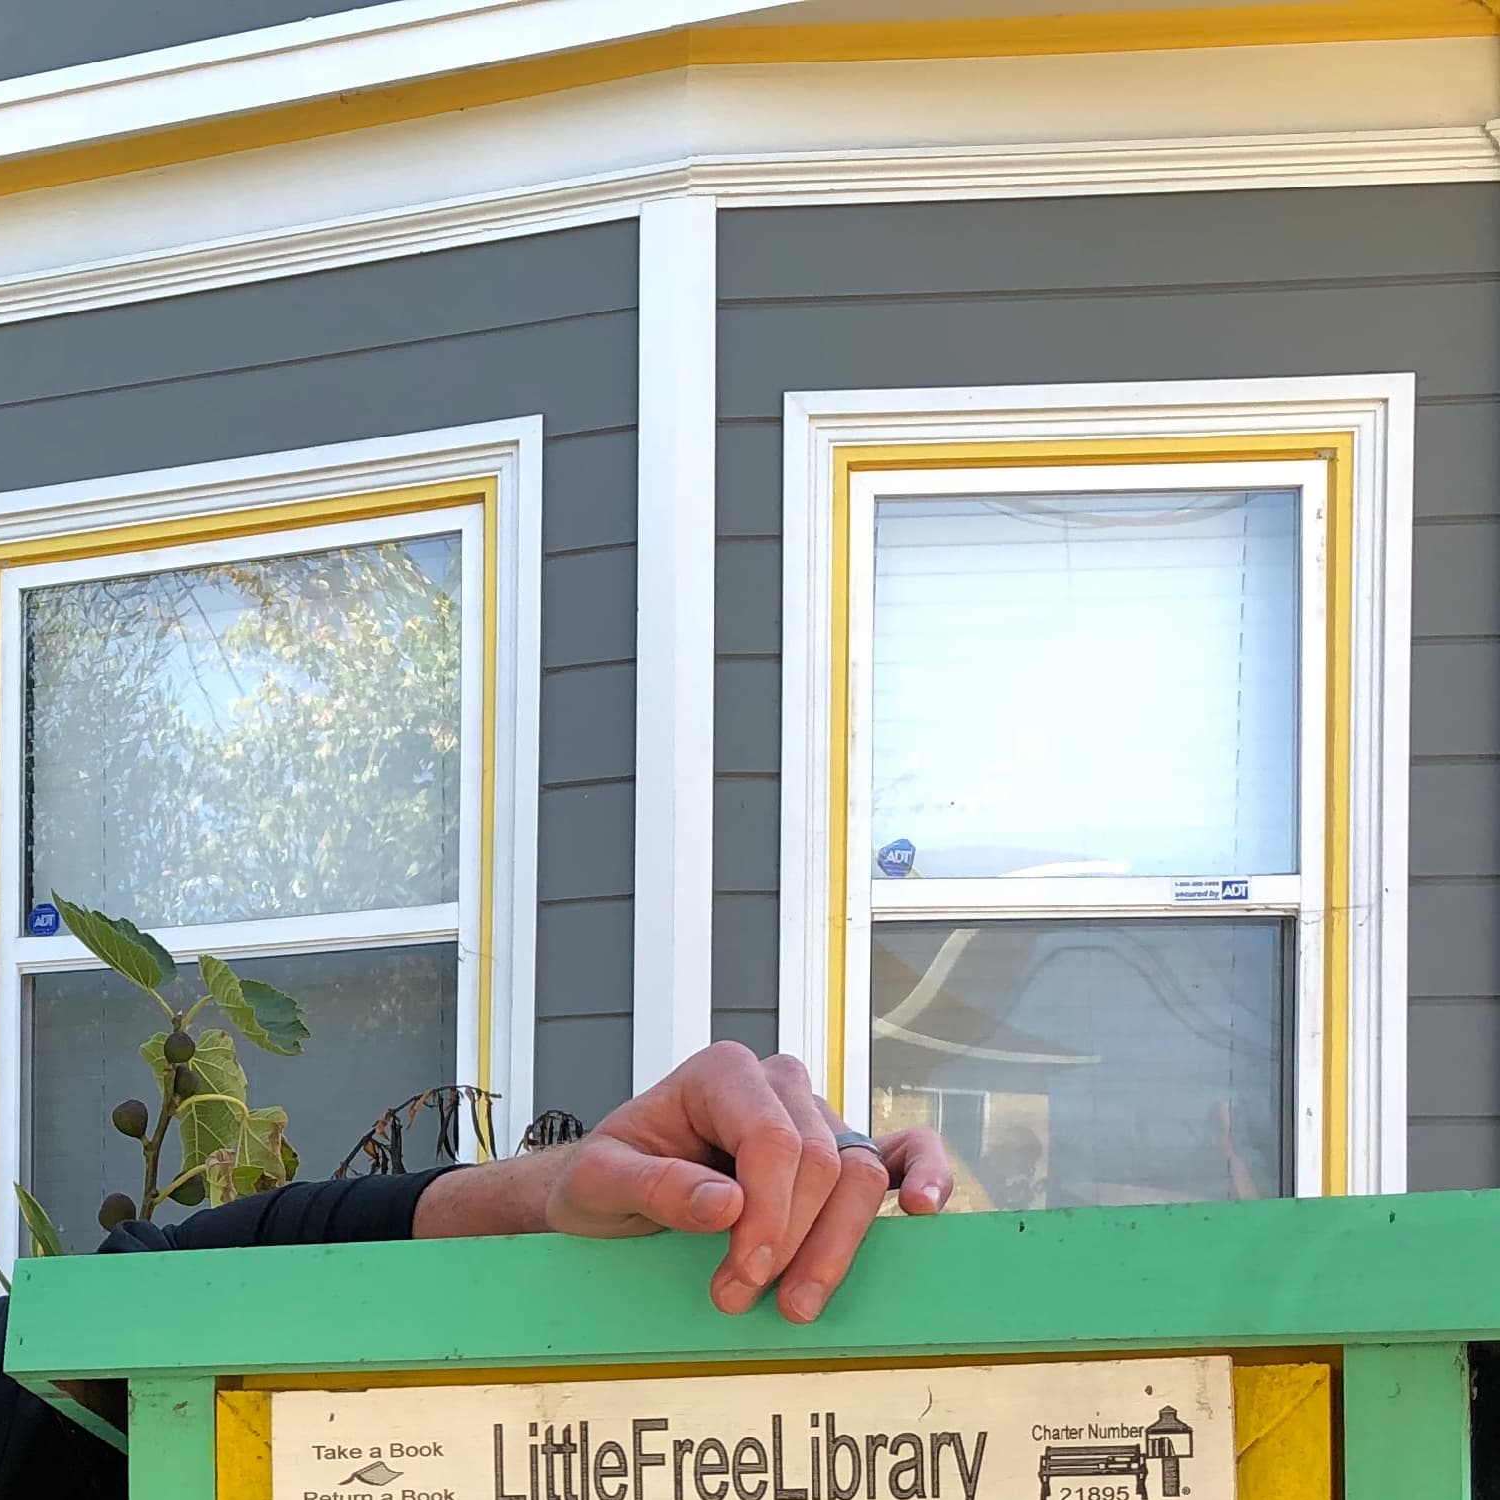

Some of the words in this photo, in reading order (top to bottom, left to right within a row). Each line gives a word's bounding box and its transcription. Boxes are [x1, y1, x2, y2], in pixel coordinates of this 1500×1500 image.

[885, 849, 912, 864] ADT
[1209, 889, 1219, 898] by
[1222, 884, 1248, 898] ADT
[33, 914, 55, 928] ADT
[1031, 1424, 1084, 1441] Charter
[1088, 1422, 1145, 1440] Number
[311, 1443, 363, 1460] Take
[369, 1446, 382, 1459] a
[390, 1441, 444, 1458] Book
